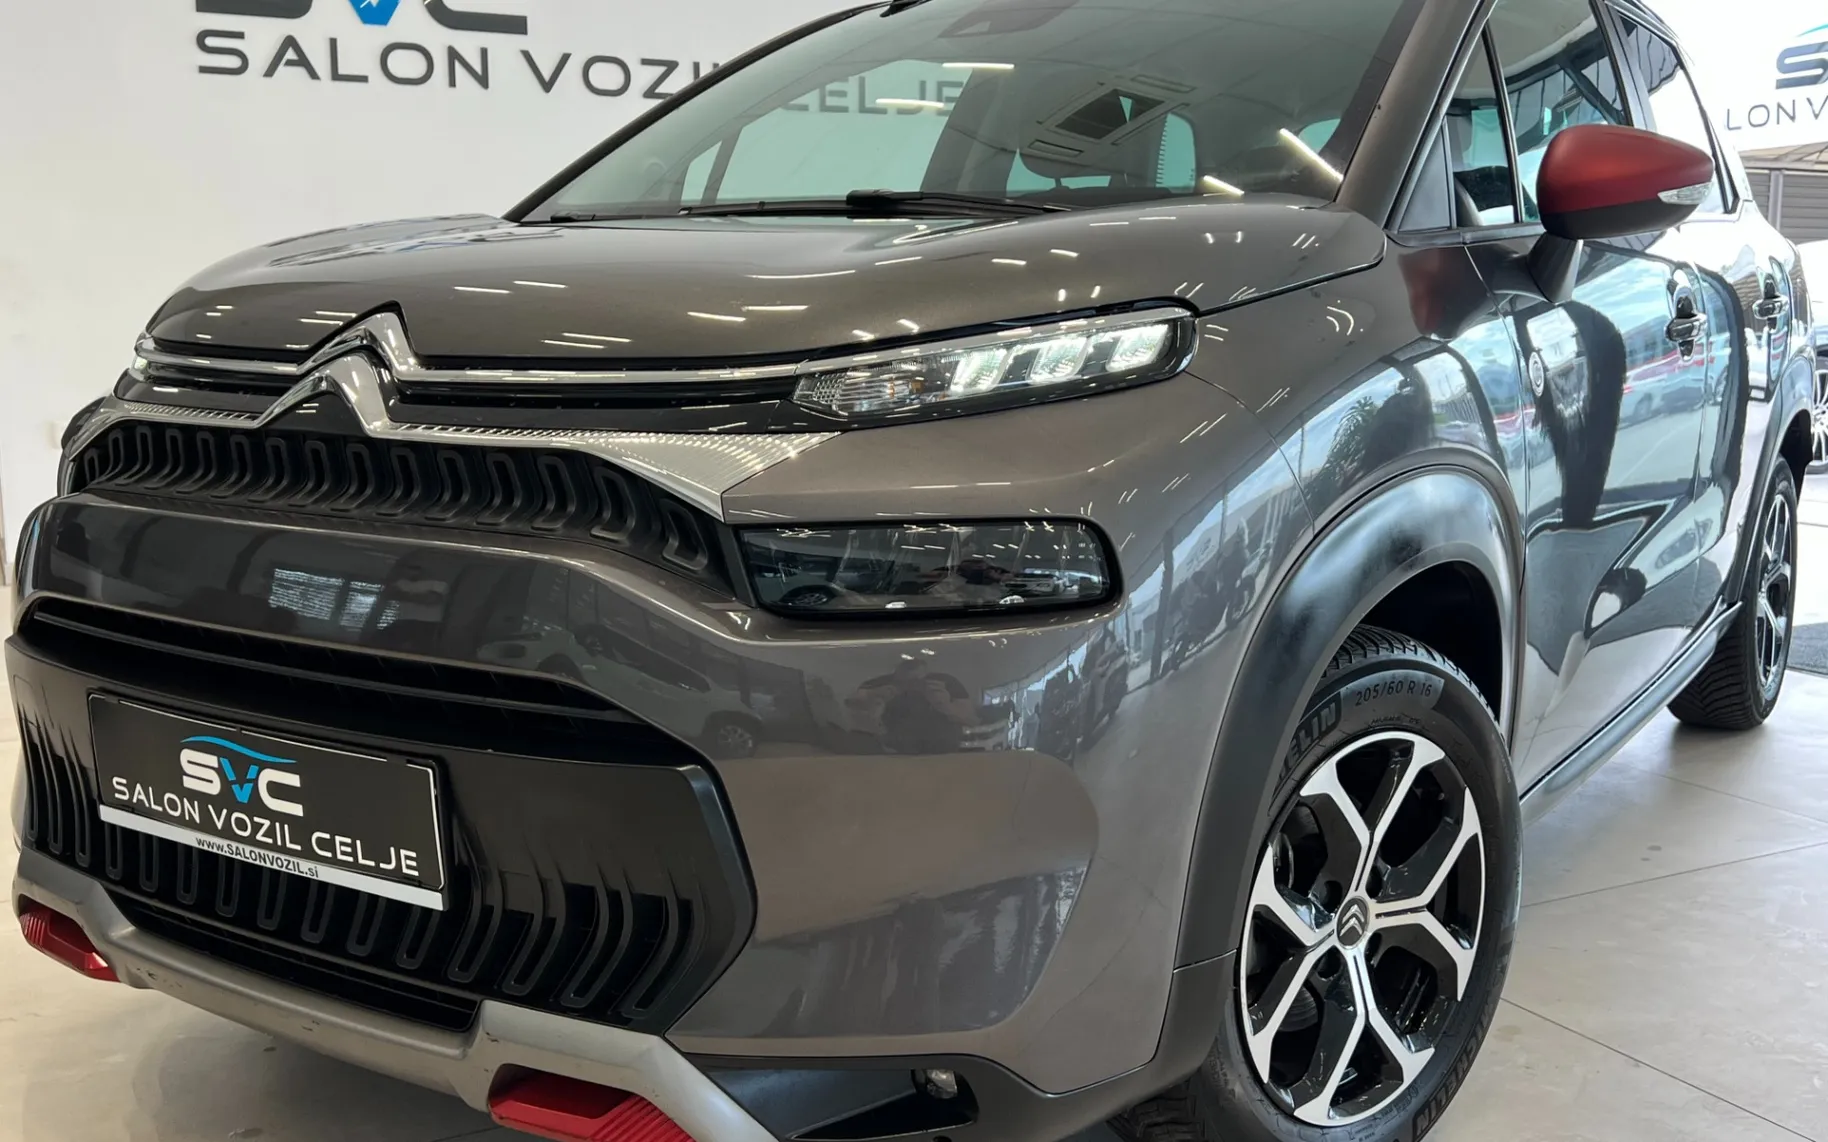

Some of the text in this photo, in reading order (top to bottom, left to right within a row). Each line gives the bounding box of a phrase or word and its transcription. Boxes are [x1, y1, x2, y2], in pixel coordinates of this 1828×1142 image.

[196, 29, 964, 116] SALON VOZ ELJE
[1355, 680, 1433, 707] 205/60 R 16
[179, 748, 304, 817] SVC
[111, 776, 419, 876] SALON VOZIL CELJE
[195, 837, 319, 878] www.SALONVOZIL.si
